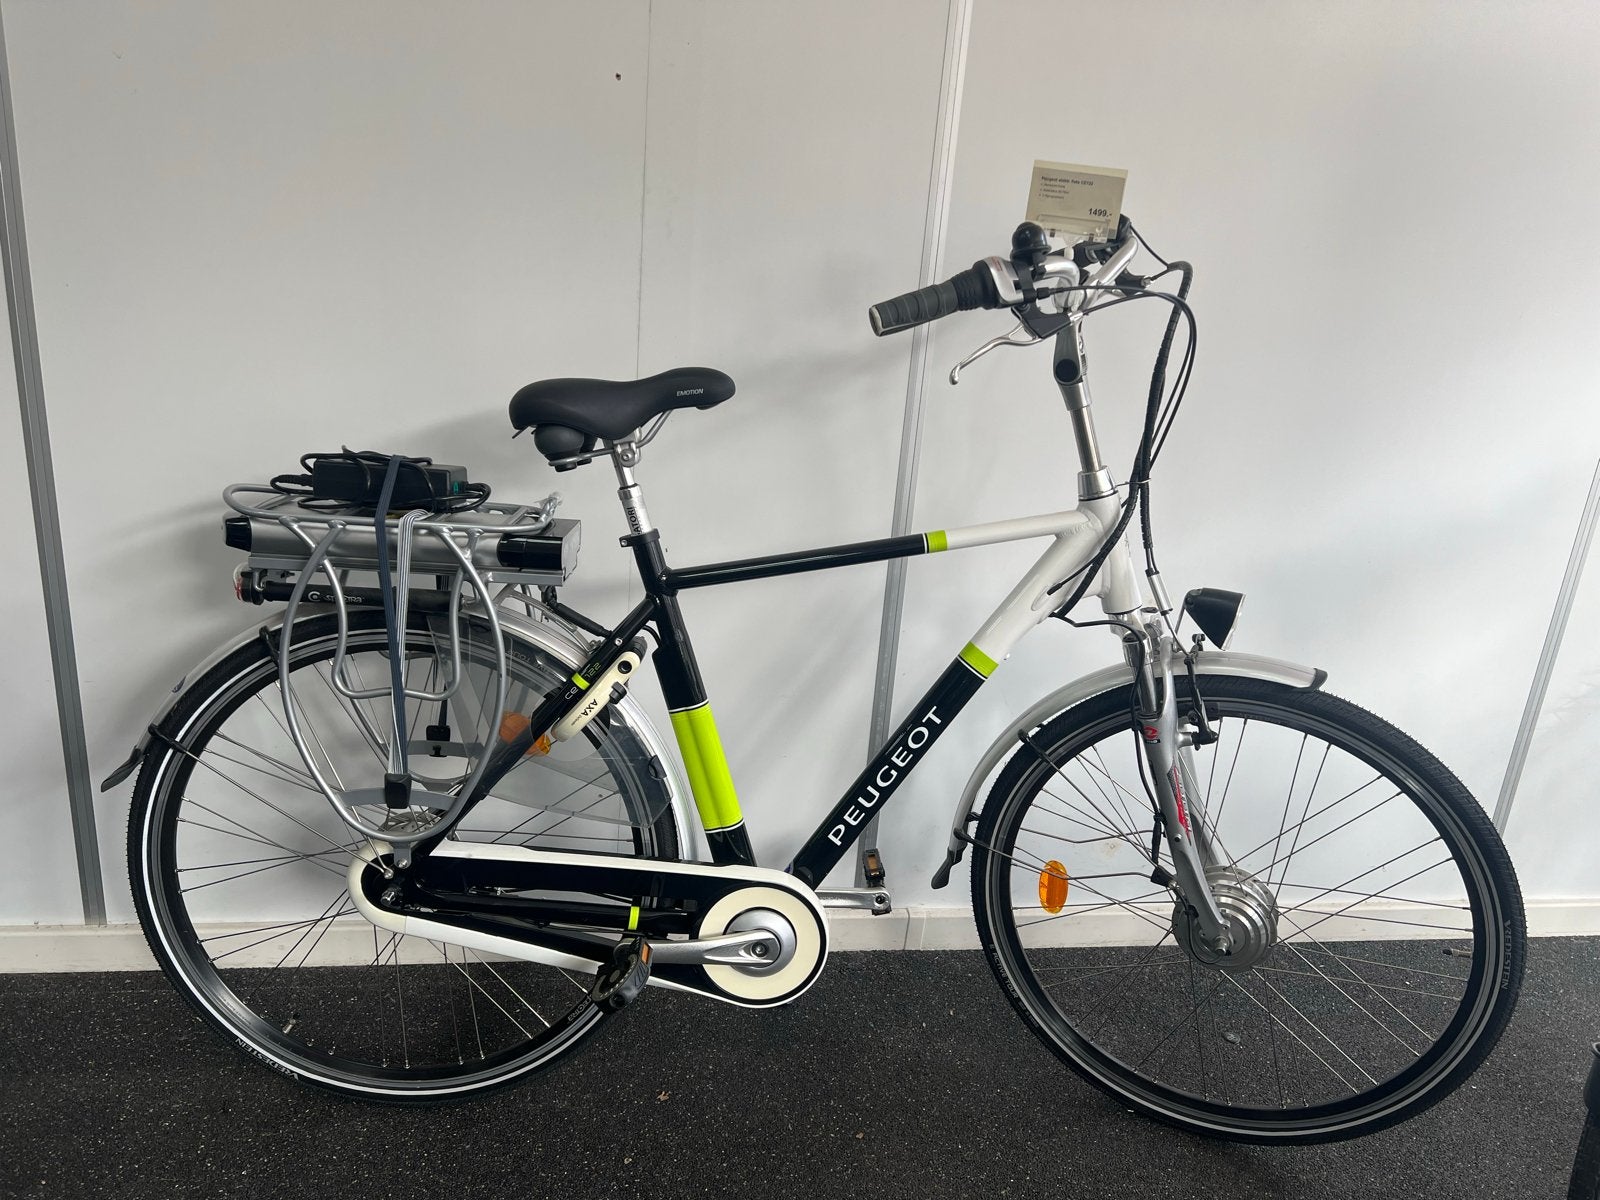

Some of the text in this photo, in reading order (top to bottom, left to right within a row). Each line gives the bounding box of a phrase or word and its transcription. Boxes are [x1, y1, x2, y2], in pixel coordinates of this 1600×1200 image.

[676, 388, 704, 397] EMOTION
[626, 507, 642, 535] ATORI
[584, 662, 601, 678] 122
[827, 705, 942, 847] PEUGEOT
[1500, 919, 1512, 990] VREDESTEIN
[235, 1038, 299, 1081] VREDESTEIN
